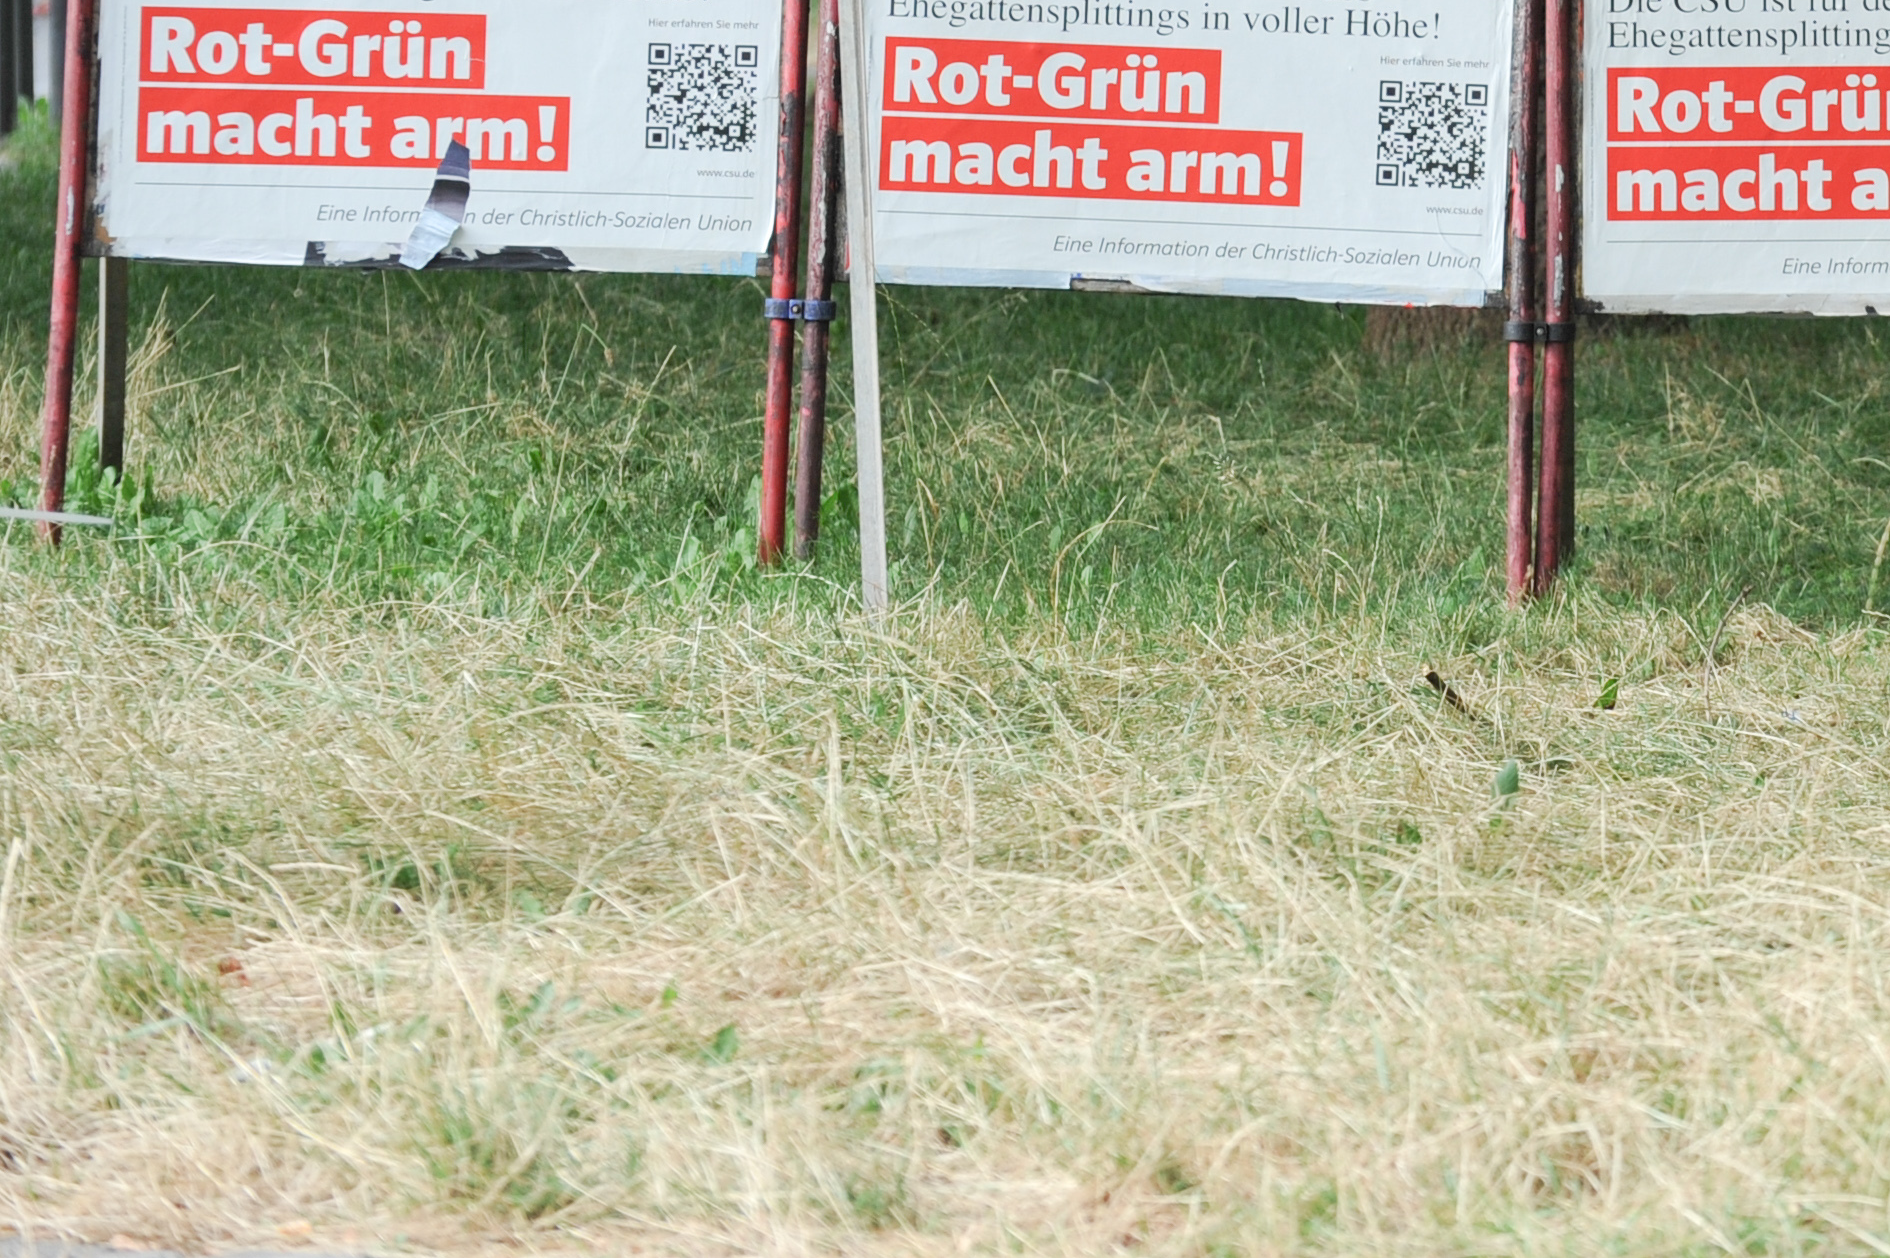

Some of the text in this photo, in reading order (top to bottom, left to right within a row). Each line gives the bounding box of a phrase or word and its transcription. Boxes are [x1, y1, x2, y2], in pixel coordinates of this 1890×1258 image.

[648, 18, 760, 30] Hier erfahren Sie mehr
[1203, 3, 1229, 31] in
[1243, 5, 1334, 35] voller
[1344, 9, 1440, 39] Höhe!
[151, 15, 472, 80] Rot-Grün
[1379, 55, 1490, 69] Hier erfahren Sie mehr
[894, 46, 1206, 114] Rot-Grün
[147, 97, 558, 163] macht arm!
[697, 168, 756, 179] www.csu.de
[889, 129, 1290, 198] macht arm!
[1617, 153, 1832, 212] macht
[316, 204, 753, 232] Eine Informn der Christlich-Sozialen Union
[1426, 205, 1484, 216] www.csu.de
[1052, 235, 1482, 269] Eine Information der Christlich-Sozialen Union
[1782, 258, 1821, 274] Eine
